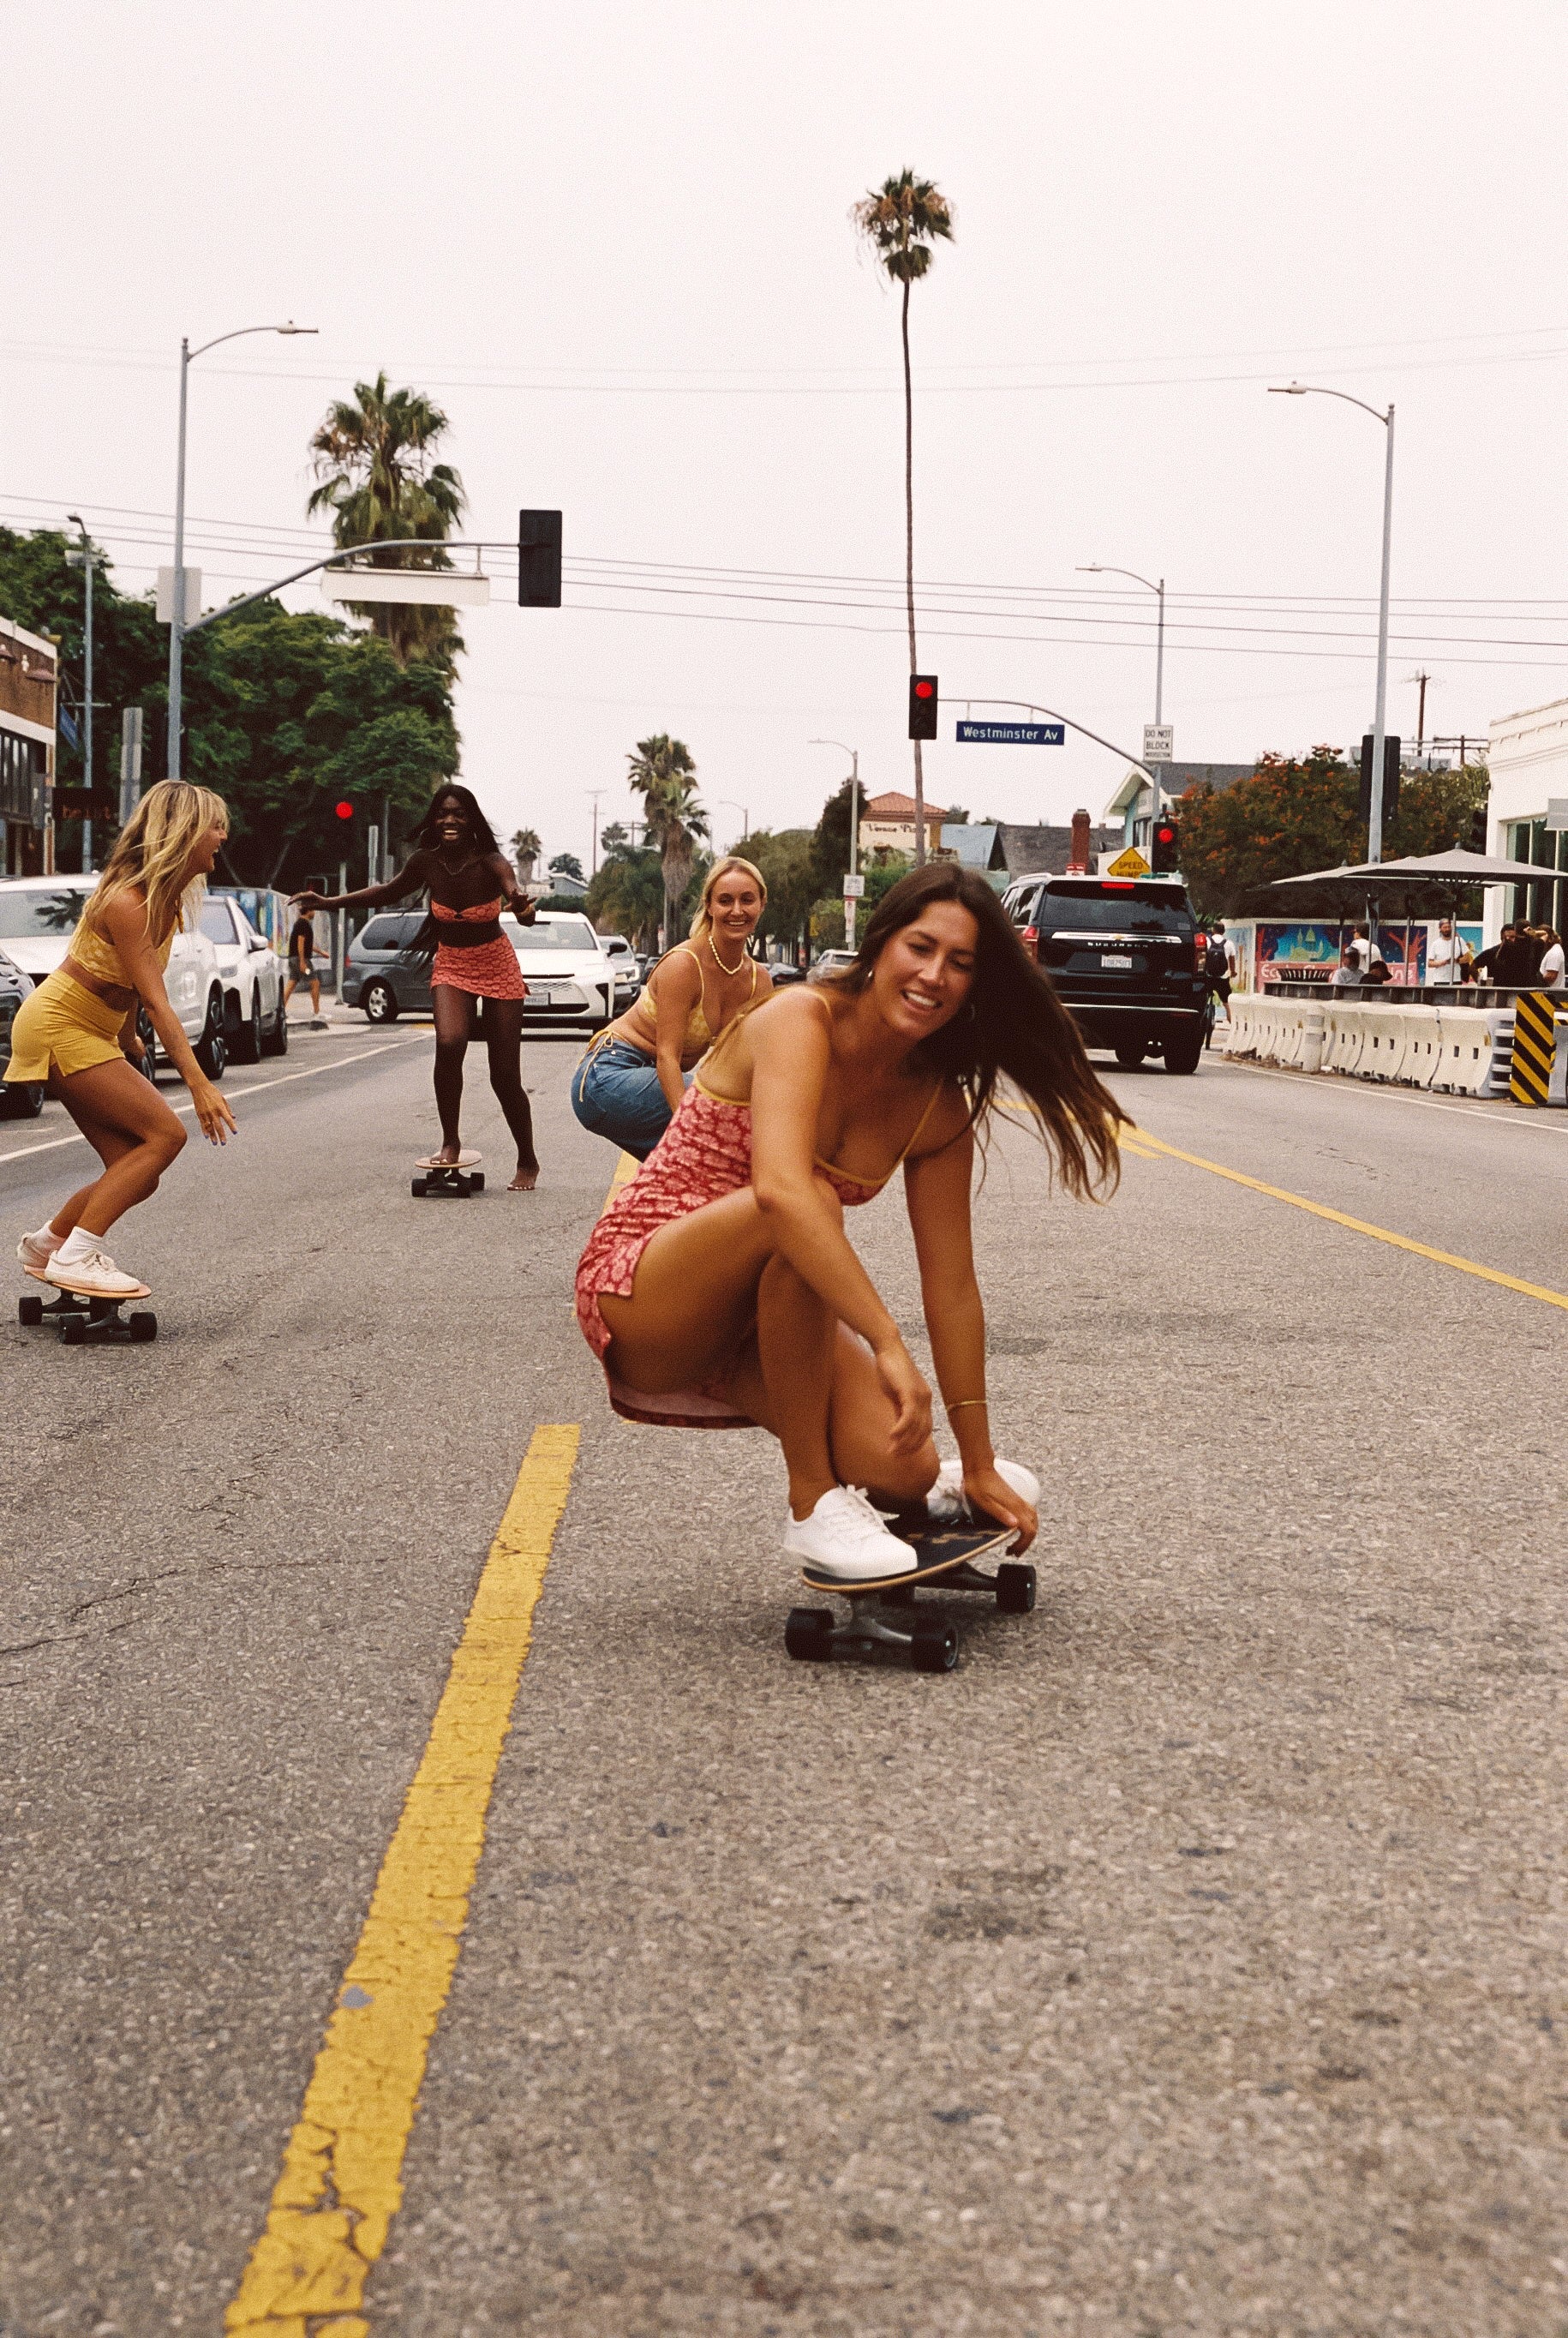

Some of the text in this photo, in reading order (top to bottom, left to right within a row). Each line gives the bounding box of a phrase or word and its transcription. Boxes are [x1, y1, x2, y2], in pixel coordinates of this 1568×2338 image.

[963, 726, 1058, 740] Westminster Av
[1145, 729, 1171, 738] DO NOT
[1146, 740, 1170, 750] BLOCK
[1116, 871, 1144, 879] HUMP
